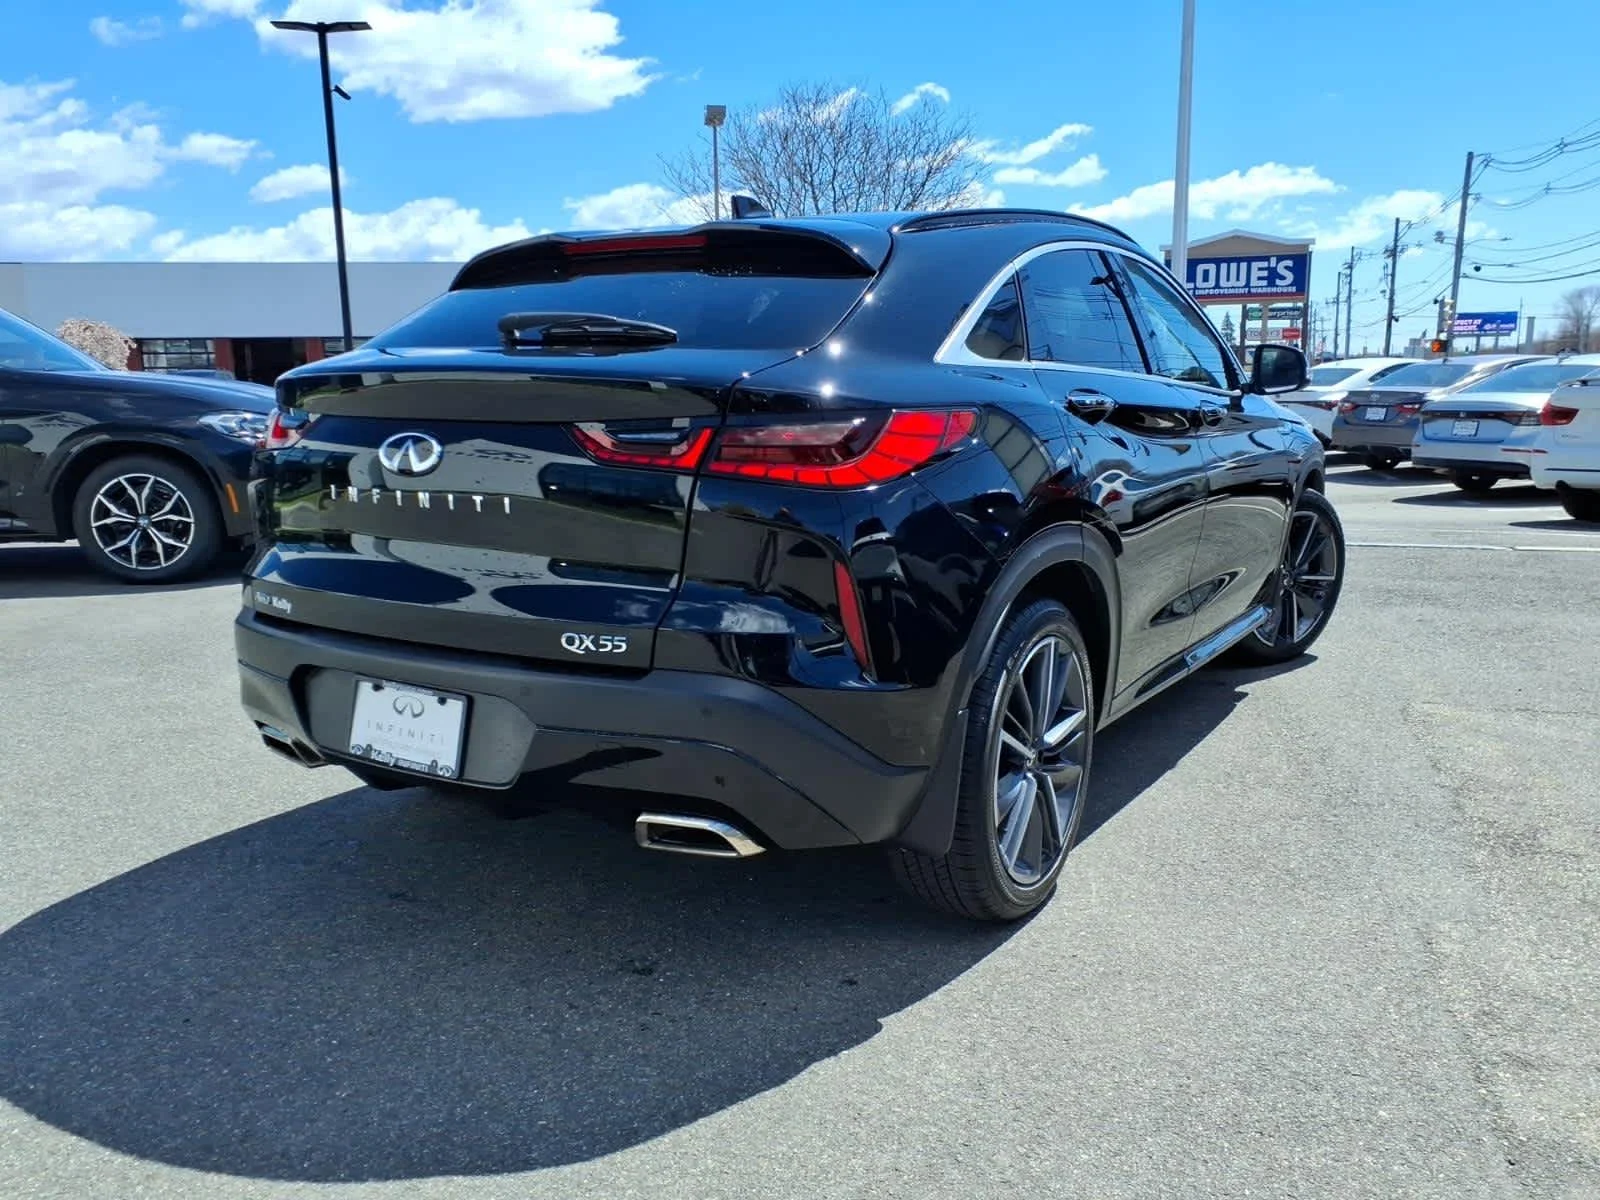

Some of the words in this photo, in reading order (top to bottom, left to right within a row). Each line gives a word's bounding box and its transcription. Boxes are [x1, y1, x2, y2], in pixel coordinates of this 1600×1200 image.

[1186, 257, 1295, 288] OWE'S
[1195, 287, 1249, 296] IMPROVEMENT
[1250, 285, 1297, 294] WAREHOUSE
[330, 484, 511, 515] INFINITI
[560, 632, 628, 654] QX55
[367, 719, 444, 743] INFINITI
